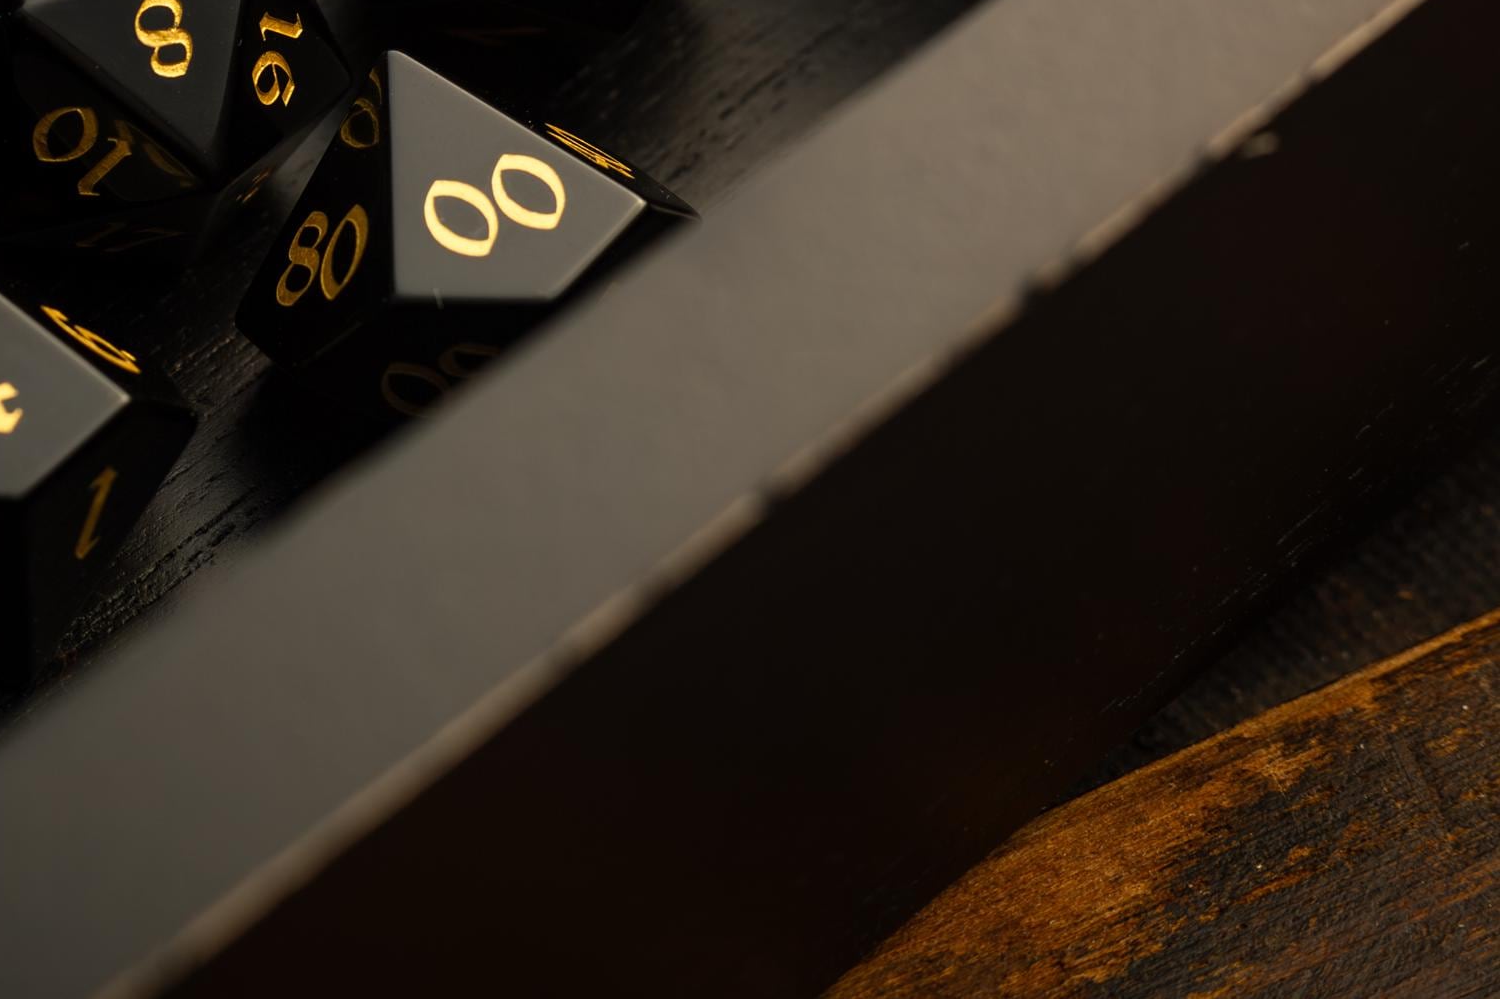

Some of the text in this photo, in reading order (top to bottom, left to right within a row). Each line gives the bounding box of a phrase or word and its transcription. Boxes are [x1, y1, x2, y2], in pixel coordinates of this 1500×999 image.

[250, 10, 304, 107] 16
[31, 105, 134, 198] 10
[420, 150, 570, 261] 00
[274, 203, 370, 308] 80
[73, 466, 118, 561] 1
